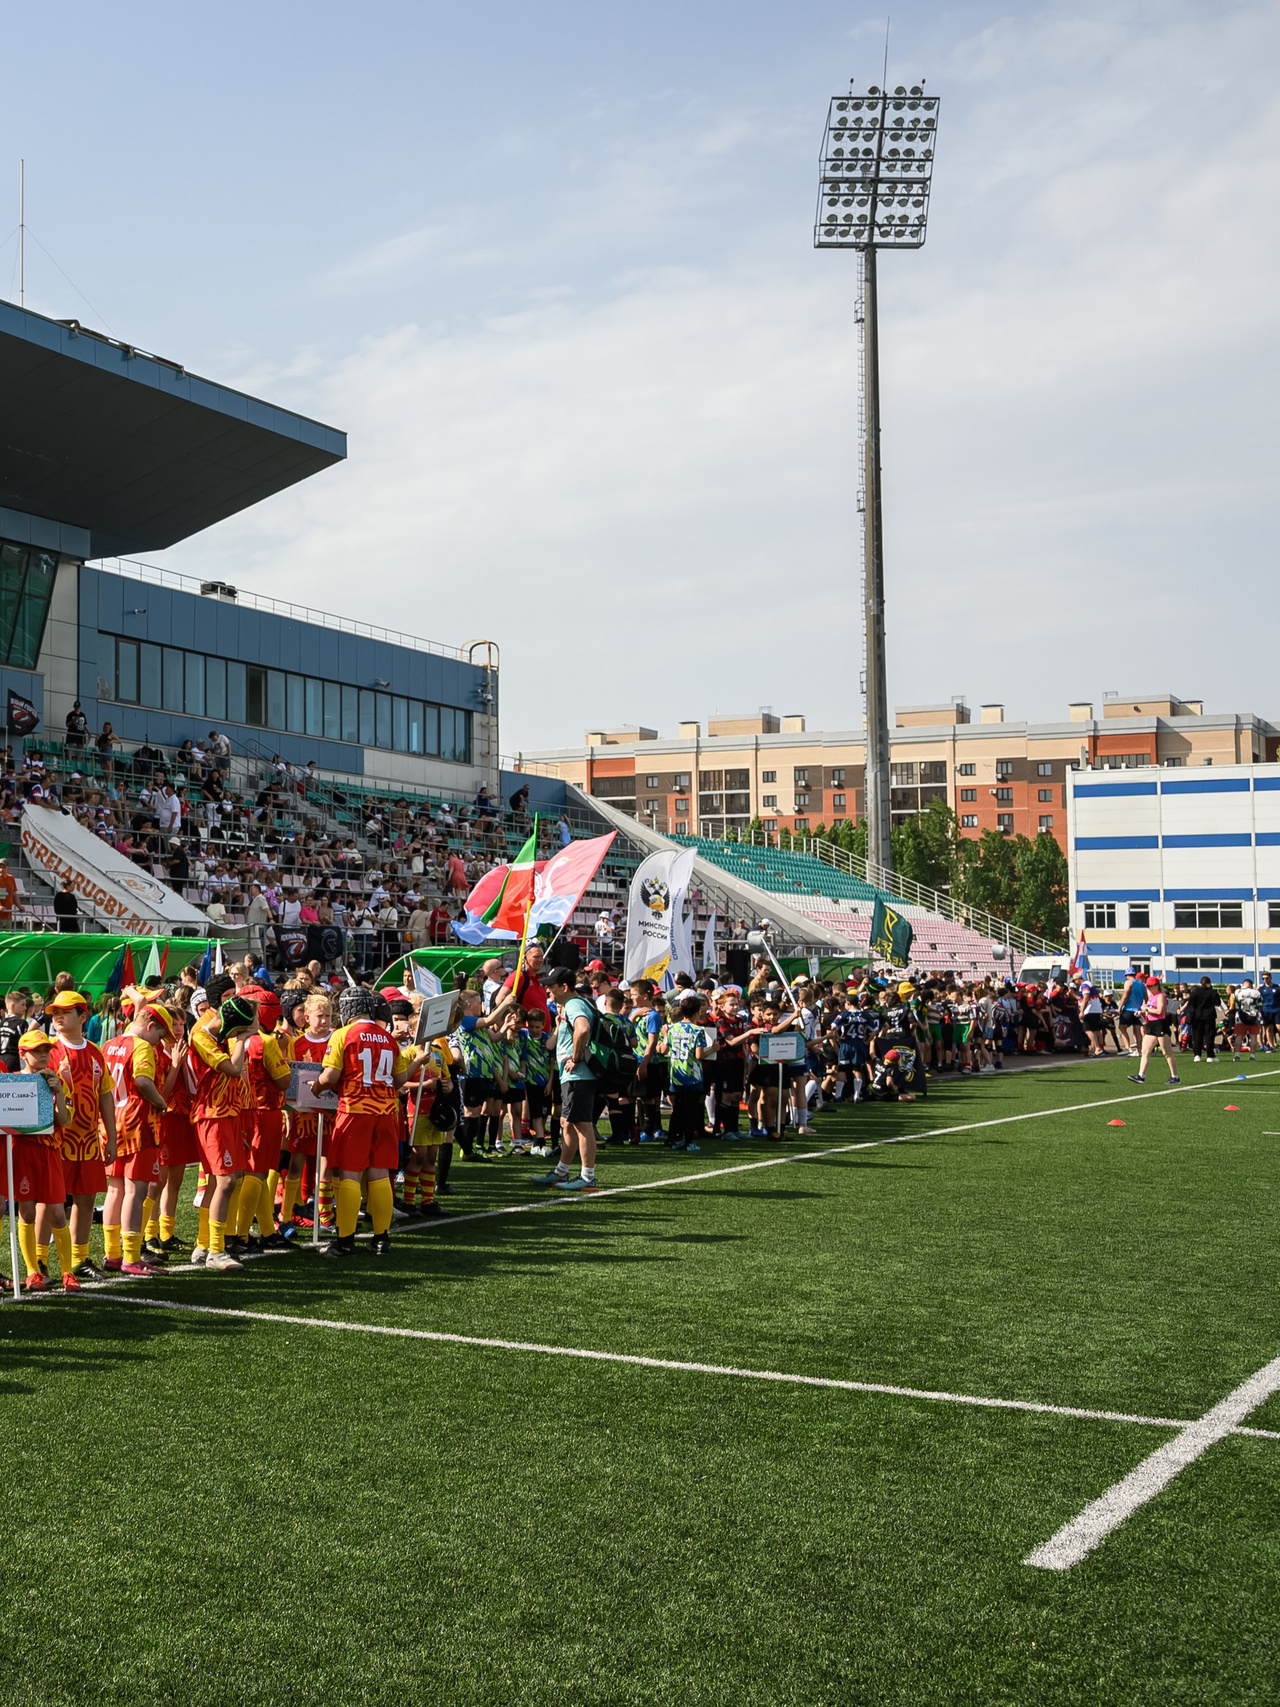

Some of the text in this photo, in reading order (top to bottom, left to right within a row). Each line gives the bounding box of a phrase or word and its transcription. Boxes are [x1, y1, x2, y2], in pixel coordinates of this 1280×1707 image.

[21, 830, 154, 936] STRELARUGBY.RU
[642, 929, 667, 941] РОССИИ
[360, 1032, 389, 1044] СЛАВА
[672, 1038, 690, 1060] 55
[358, 1047, 394, 1088] 14
